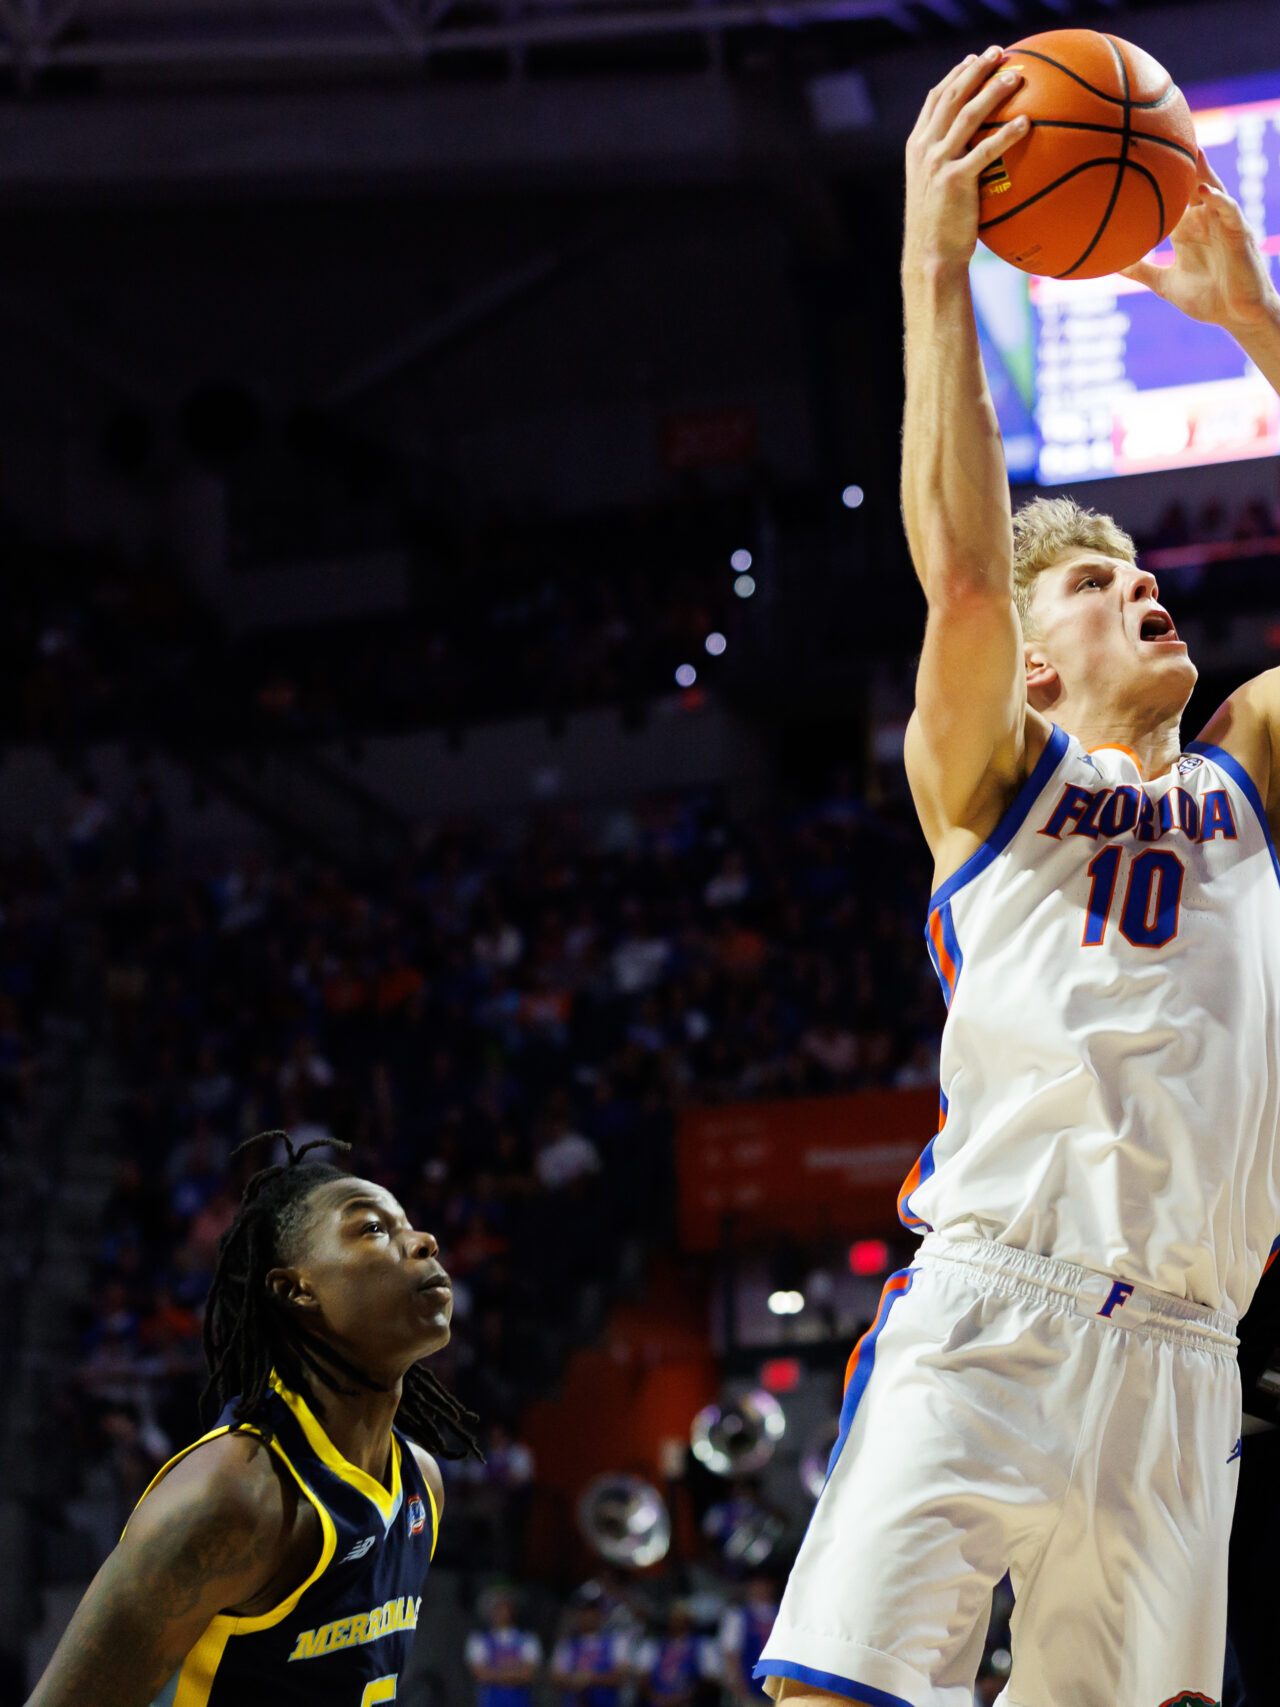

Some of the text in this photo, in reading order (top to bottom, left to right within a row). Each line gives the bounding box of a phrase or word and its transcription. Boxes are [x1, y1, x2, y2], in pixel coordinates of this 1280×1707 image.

[1037, 783, 1238, 844] FLORIDA
[1081, 844, 1185, 949] 10
[1096, 1280, 1134, 1318] F
